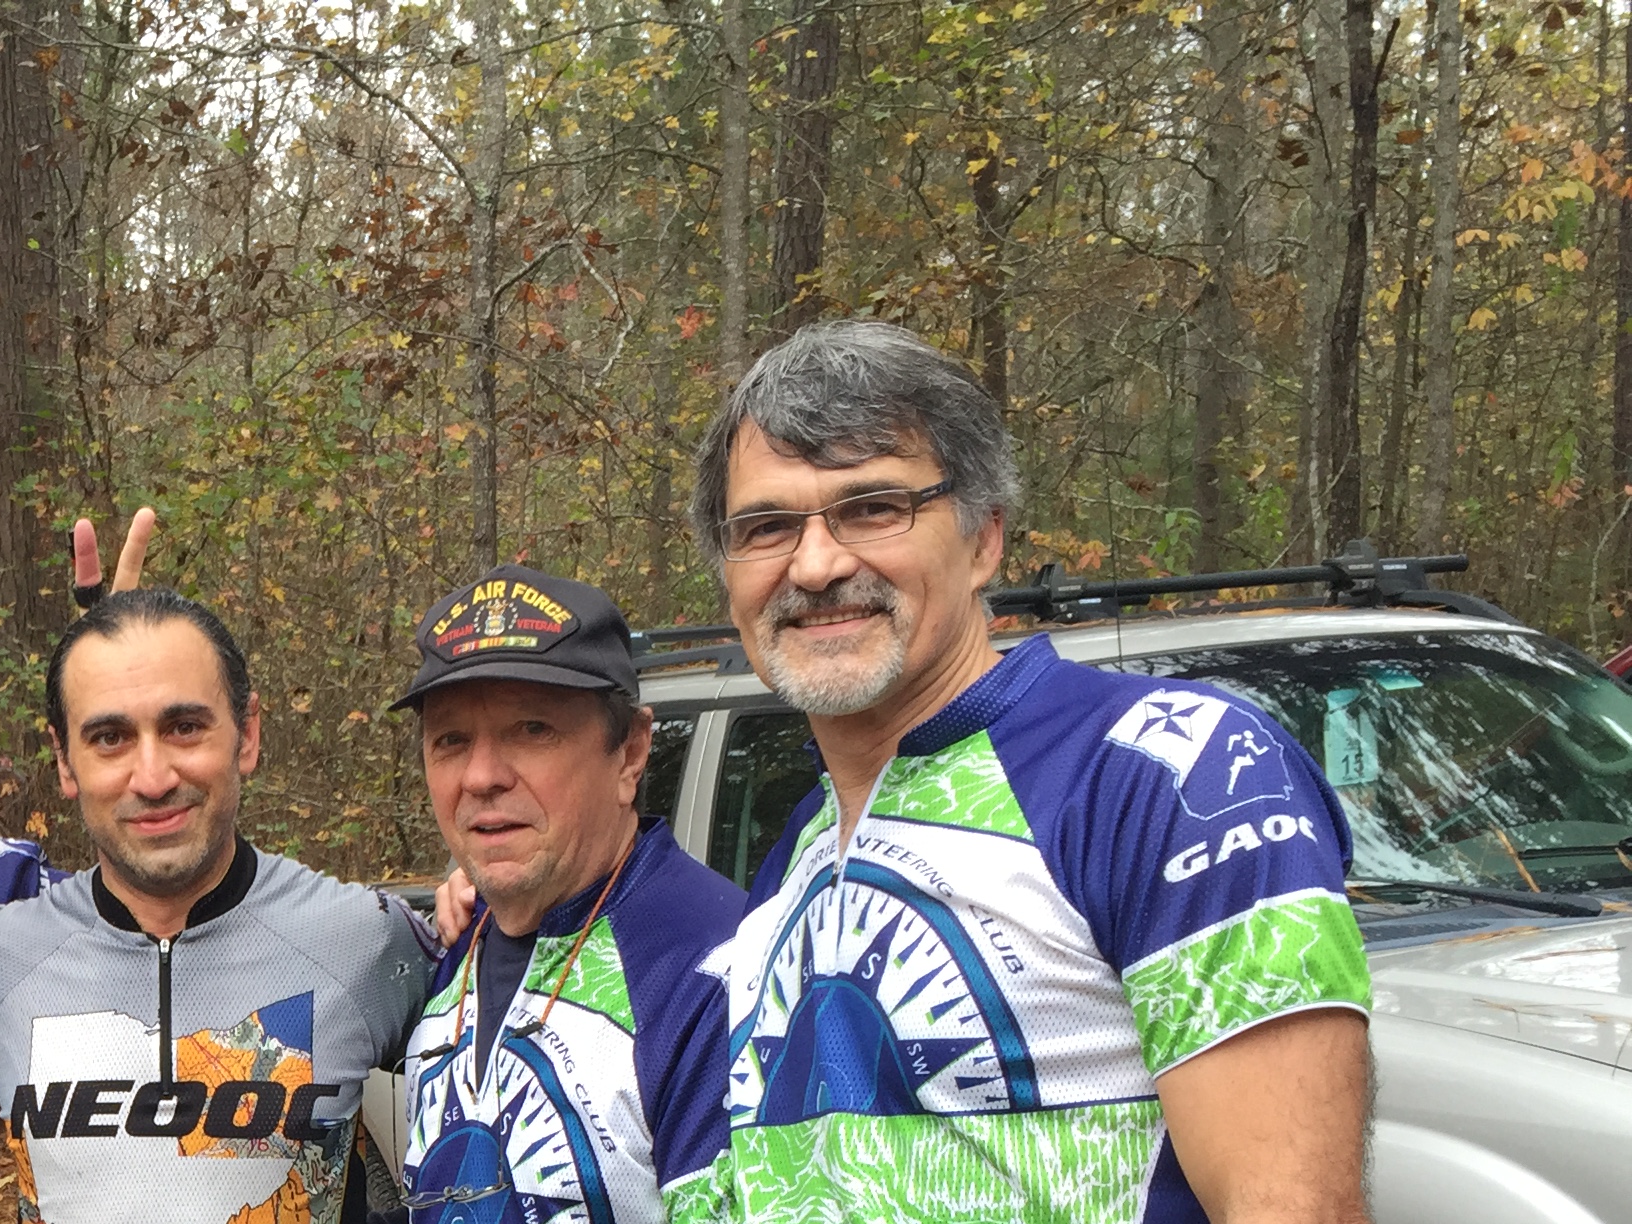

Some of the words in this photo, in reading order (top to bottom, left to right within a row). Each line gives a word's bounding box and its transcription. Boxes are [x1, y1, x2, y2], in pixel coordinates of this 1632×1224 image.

[432, 602, 469, 636] U.S.
[471, 579, 507, 606] AIR
[511, 582, 573, 626] FORCE
[516, 618, 562, 634] VETERAN
[861, 952, 883, 980] S
[906, 1042, 931, 1077] SW
[9, 1080, 341, 1141] NEOOC
[444, 1106, 460, 1128] SE
[500, 1112, 512, 1136] S
[574, 1083, 618, 1154] CLUB
